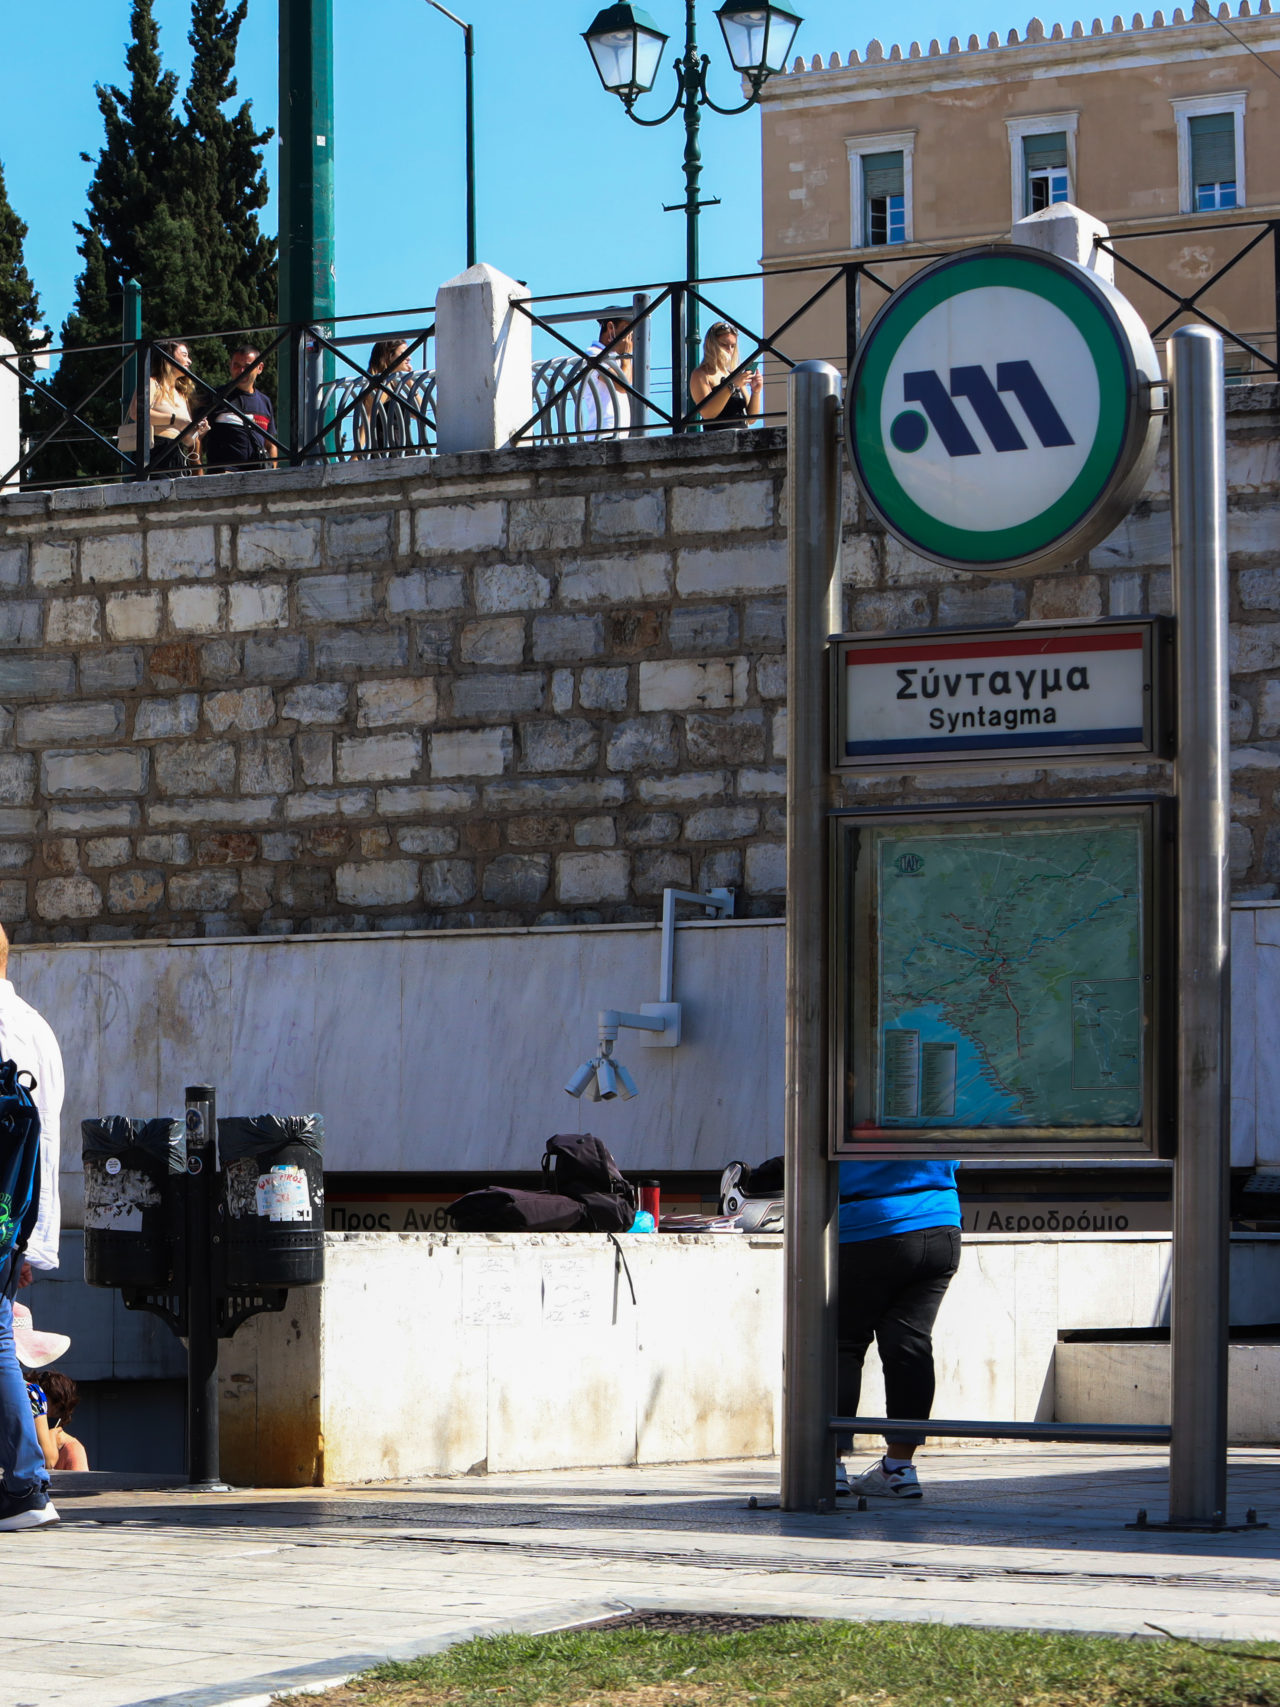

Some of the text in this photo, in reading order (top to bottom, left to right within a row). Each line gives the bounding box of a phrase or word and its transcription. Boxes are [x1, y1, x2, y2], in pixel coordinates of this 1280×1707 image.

[896, 666, 1090, 700] Σύνταγμα
[929, 706, 1057, 733] Syntagma
[331, 1207, 391, 1231] Προς
[987, 1210, 1129, 1232] Αεροδρόμιο
